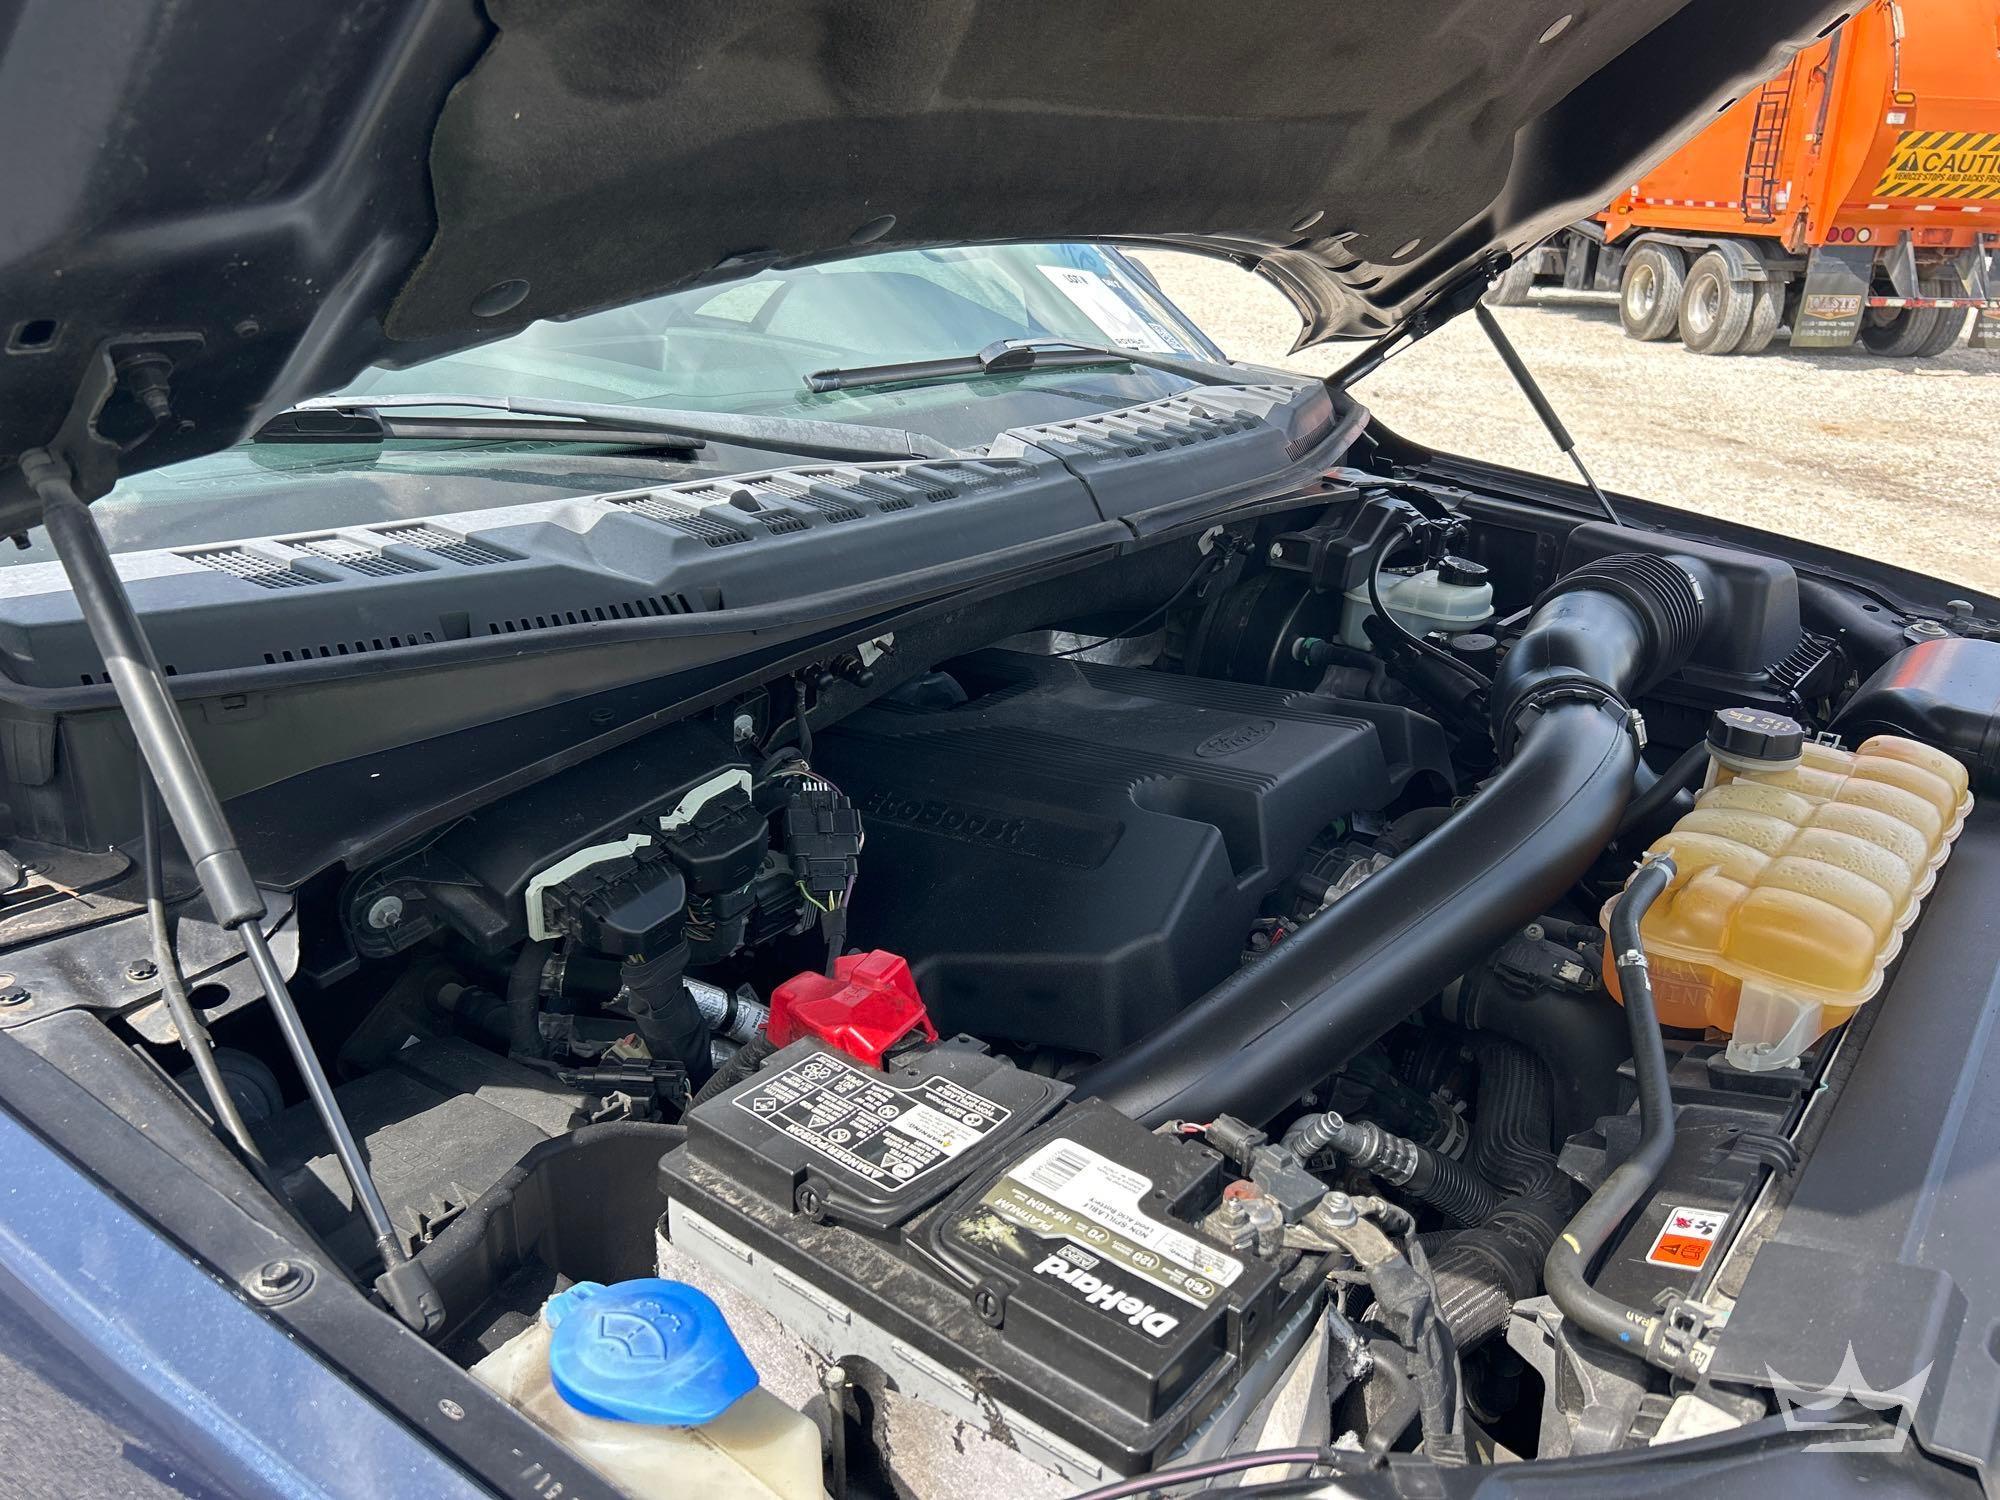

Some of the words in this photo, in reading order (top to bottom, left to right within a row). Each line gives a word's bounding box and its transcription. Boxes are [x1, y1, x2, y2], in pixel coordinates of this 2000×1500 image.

[1922, 152, 2000, 174] CAUTI
[936, 1086, 995, 1116] NON-SPILLABLE
[786, 1124, 873, 1173] DANGER/POISON
[994, 1197, 1053, 1232] PLATINUM
[1023, 1198, 1072, 1225] H6-AGM
[1086, 1227, 1106, 1242] 70
[1059, 1248, 1091, 1267] AGM
[1132, 1251, 1156, 1267] 120
[1031, 1253, 1180, 1340] DieHard
[1183, 1277, 1211, 1296] 760
